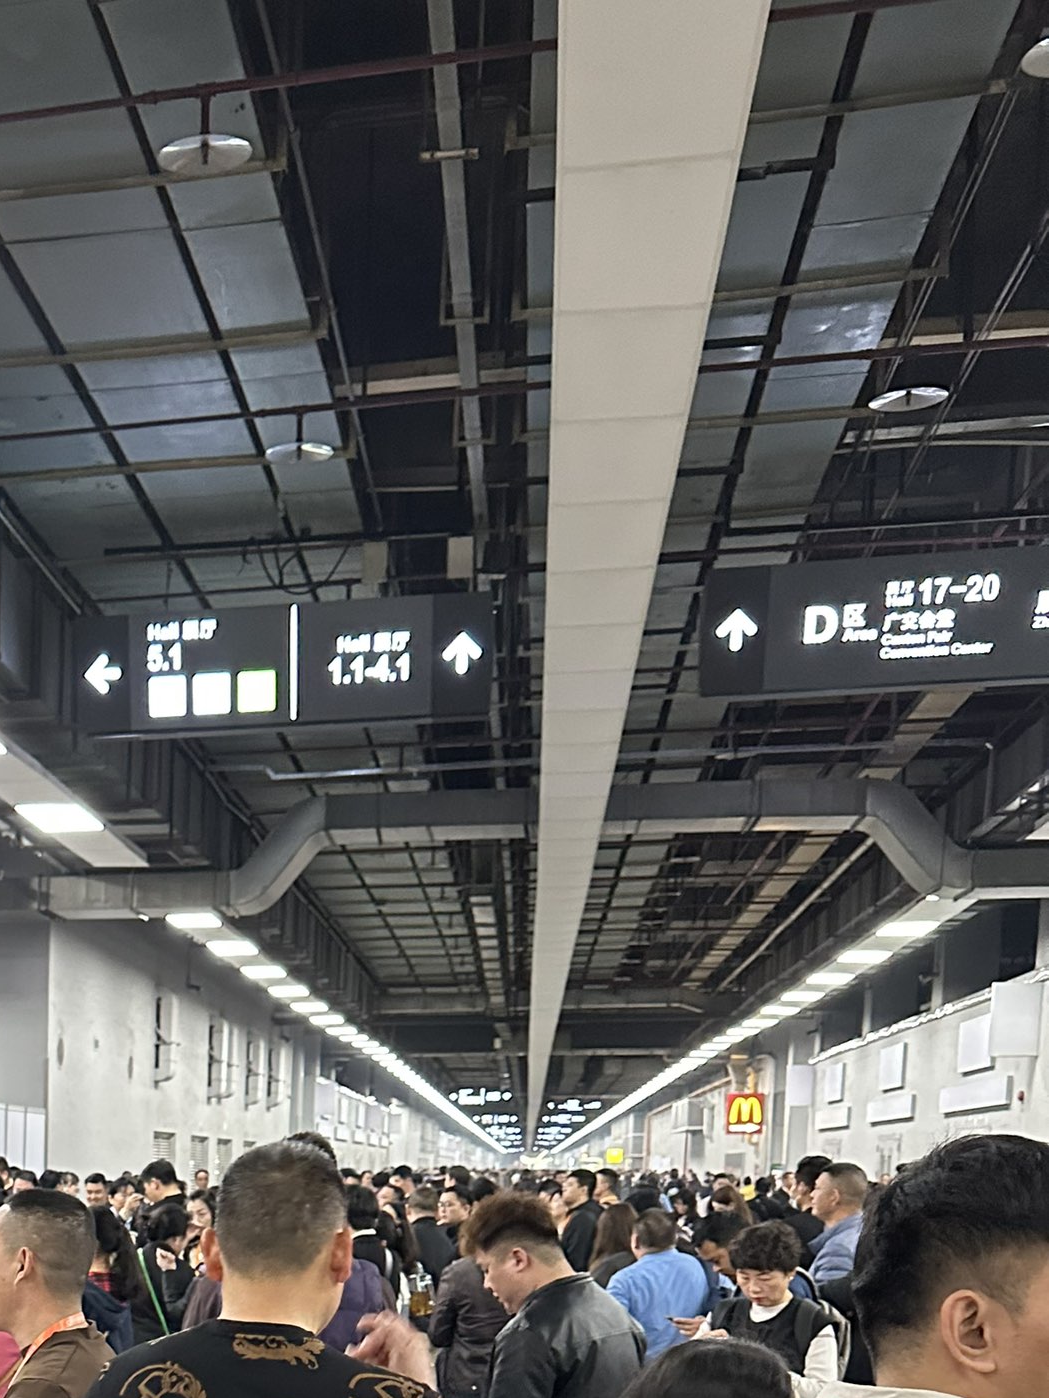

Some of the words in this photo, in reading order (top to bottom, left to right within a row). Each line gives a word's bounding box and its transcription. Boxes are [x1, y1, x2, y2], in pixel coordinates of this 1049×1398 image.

[919, 573, 1000, 605] 17-20
[146, 641, 182, 673] 5.1
[327, 652, 410, 686] 1.1-4.1
